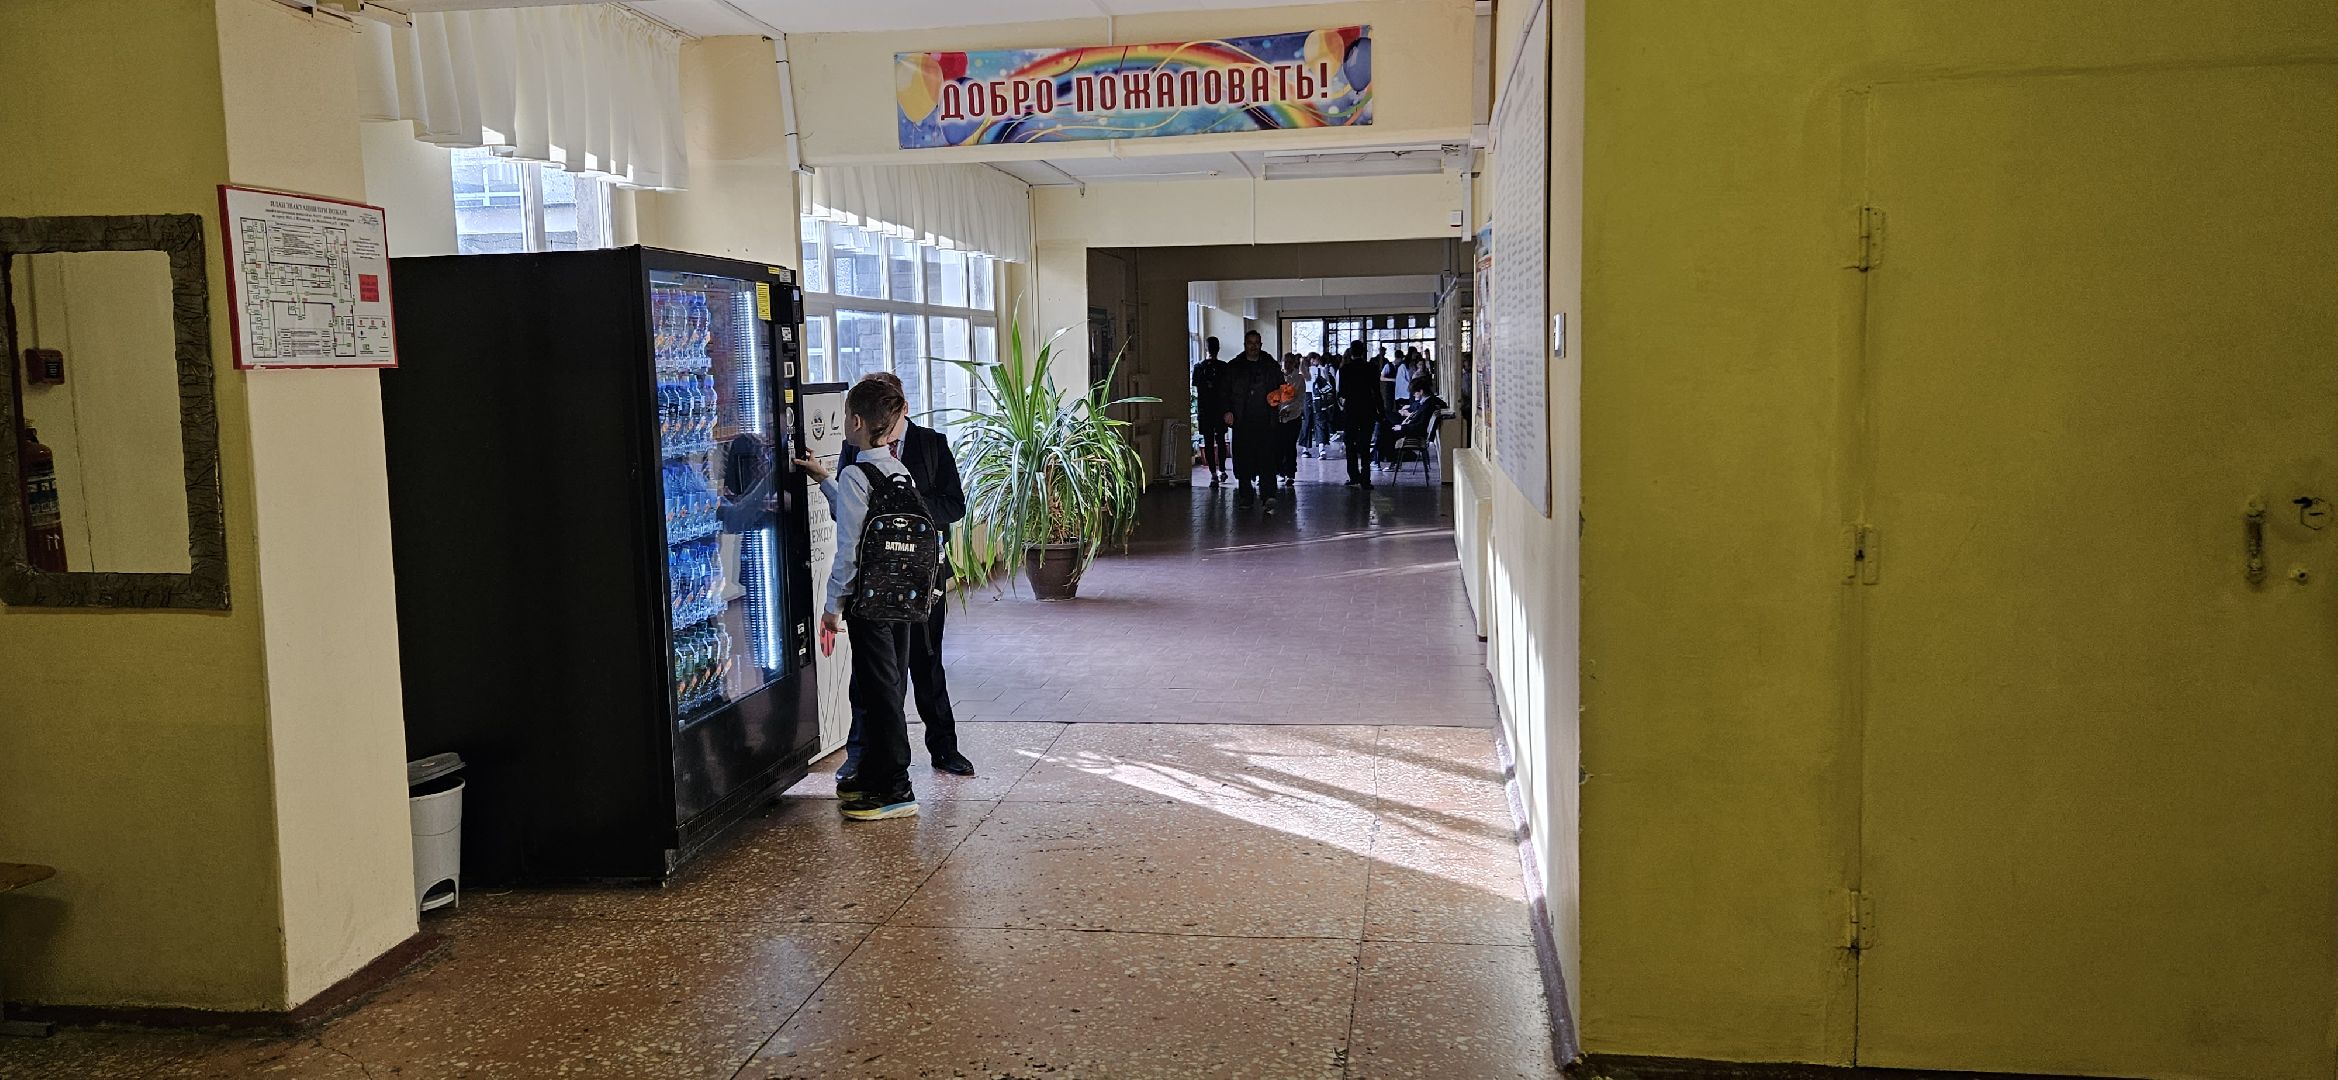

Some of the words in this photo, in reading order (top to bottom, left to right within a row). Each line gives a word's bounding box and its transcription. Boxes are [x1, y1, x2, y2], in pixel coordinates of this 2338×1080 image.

[941, 79, 1054, 120] ДОБРО
[1075, 63, 1328, 113] ПОЖАЛОВАТЬ!
[811, 526, 834, 544] ЕЖДУ
[885, 541, 915, 552] BATMAN
